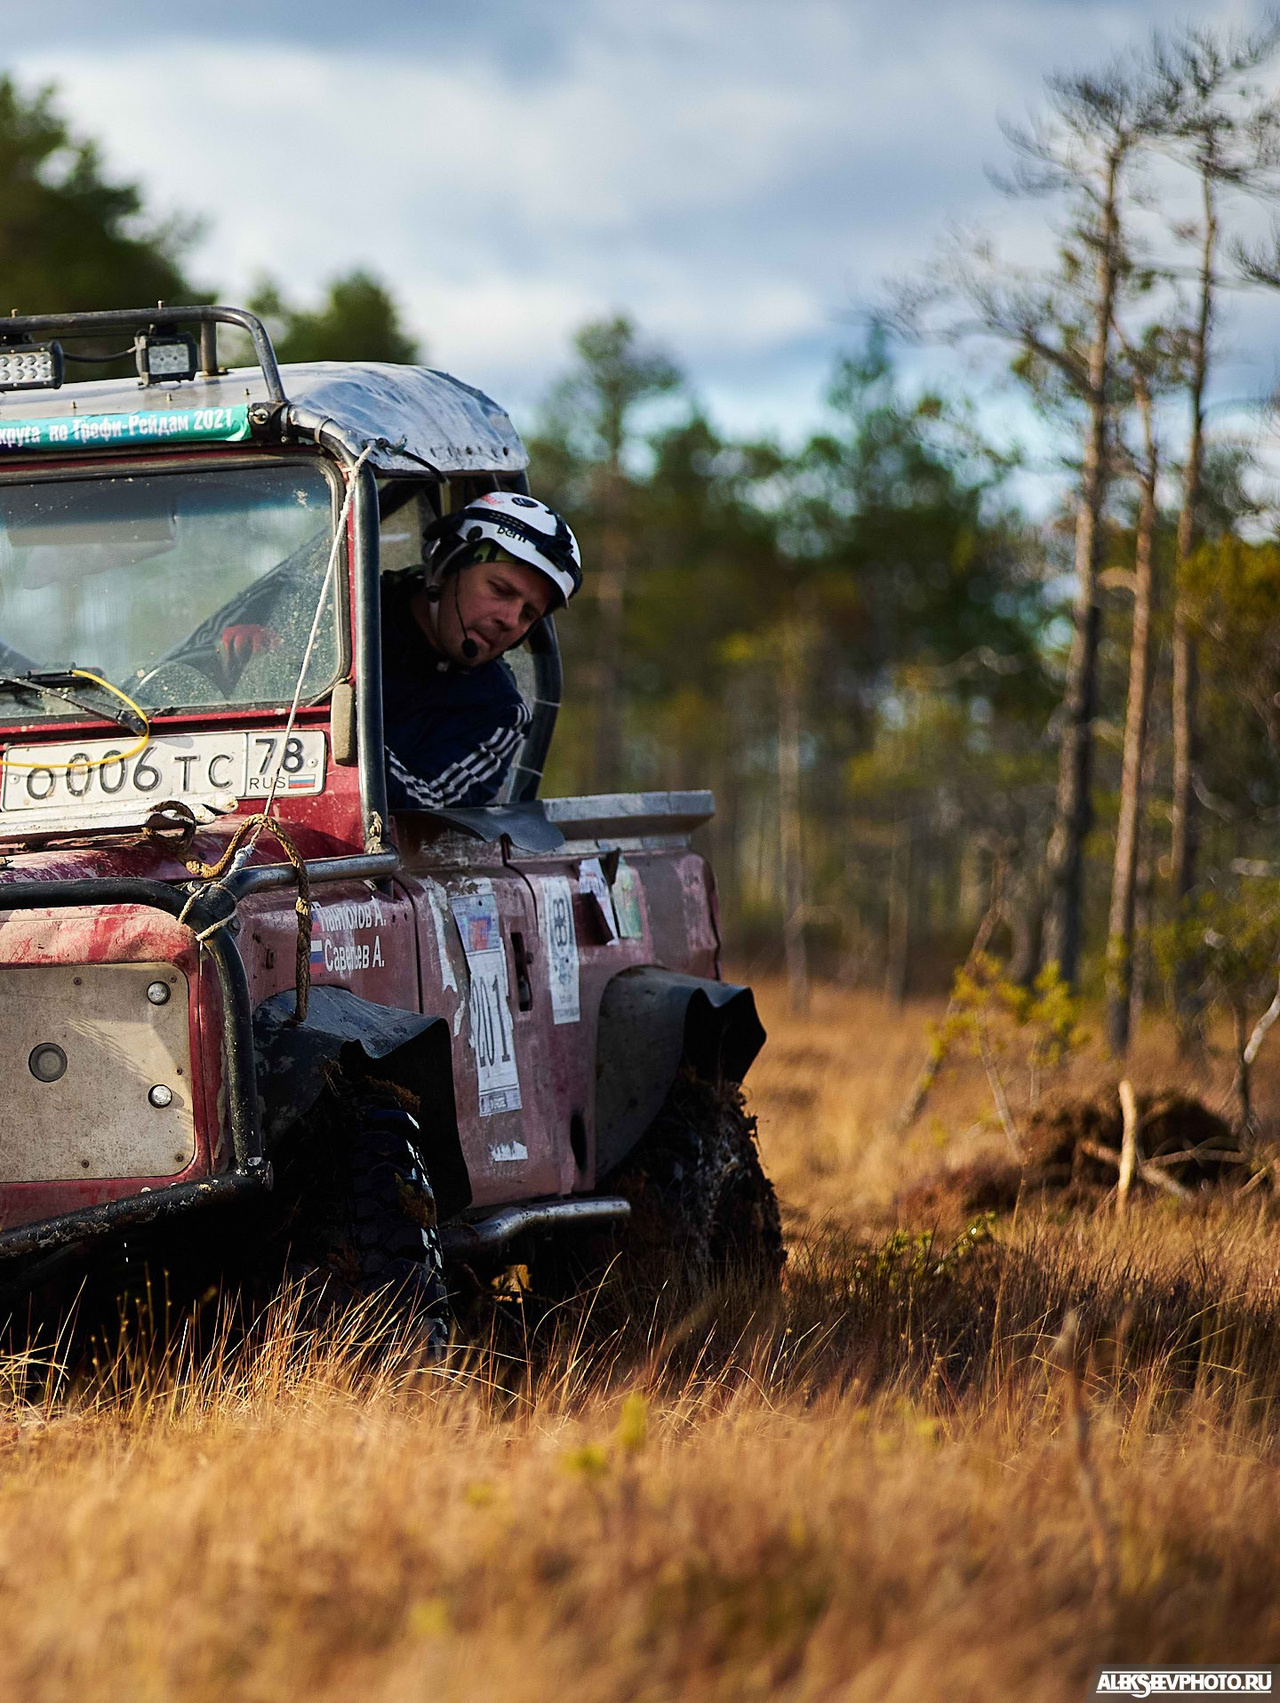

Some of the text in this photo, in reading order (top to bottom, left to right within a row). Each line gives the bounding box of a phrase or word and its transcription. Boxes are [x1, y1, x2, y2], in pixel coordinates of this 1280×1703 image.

[73, 414, 189, 443] Трофи-Рейдам
[194, 408, 233, 431] 2021
[255, 737, 304, 774] 78
[249, 776, 287, 790] RUS
